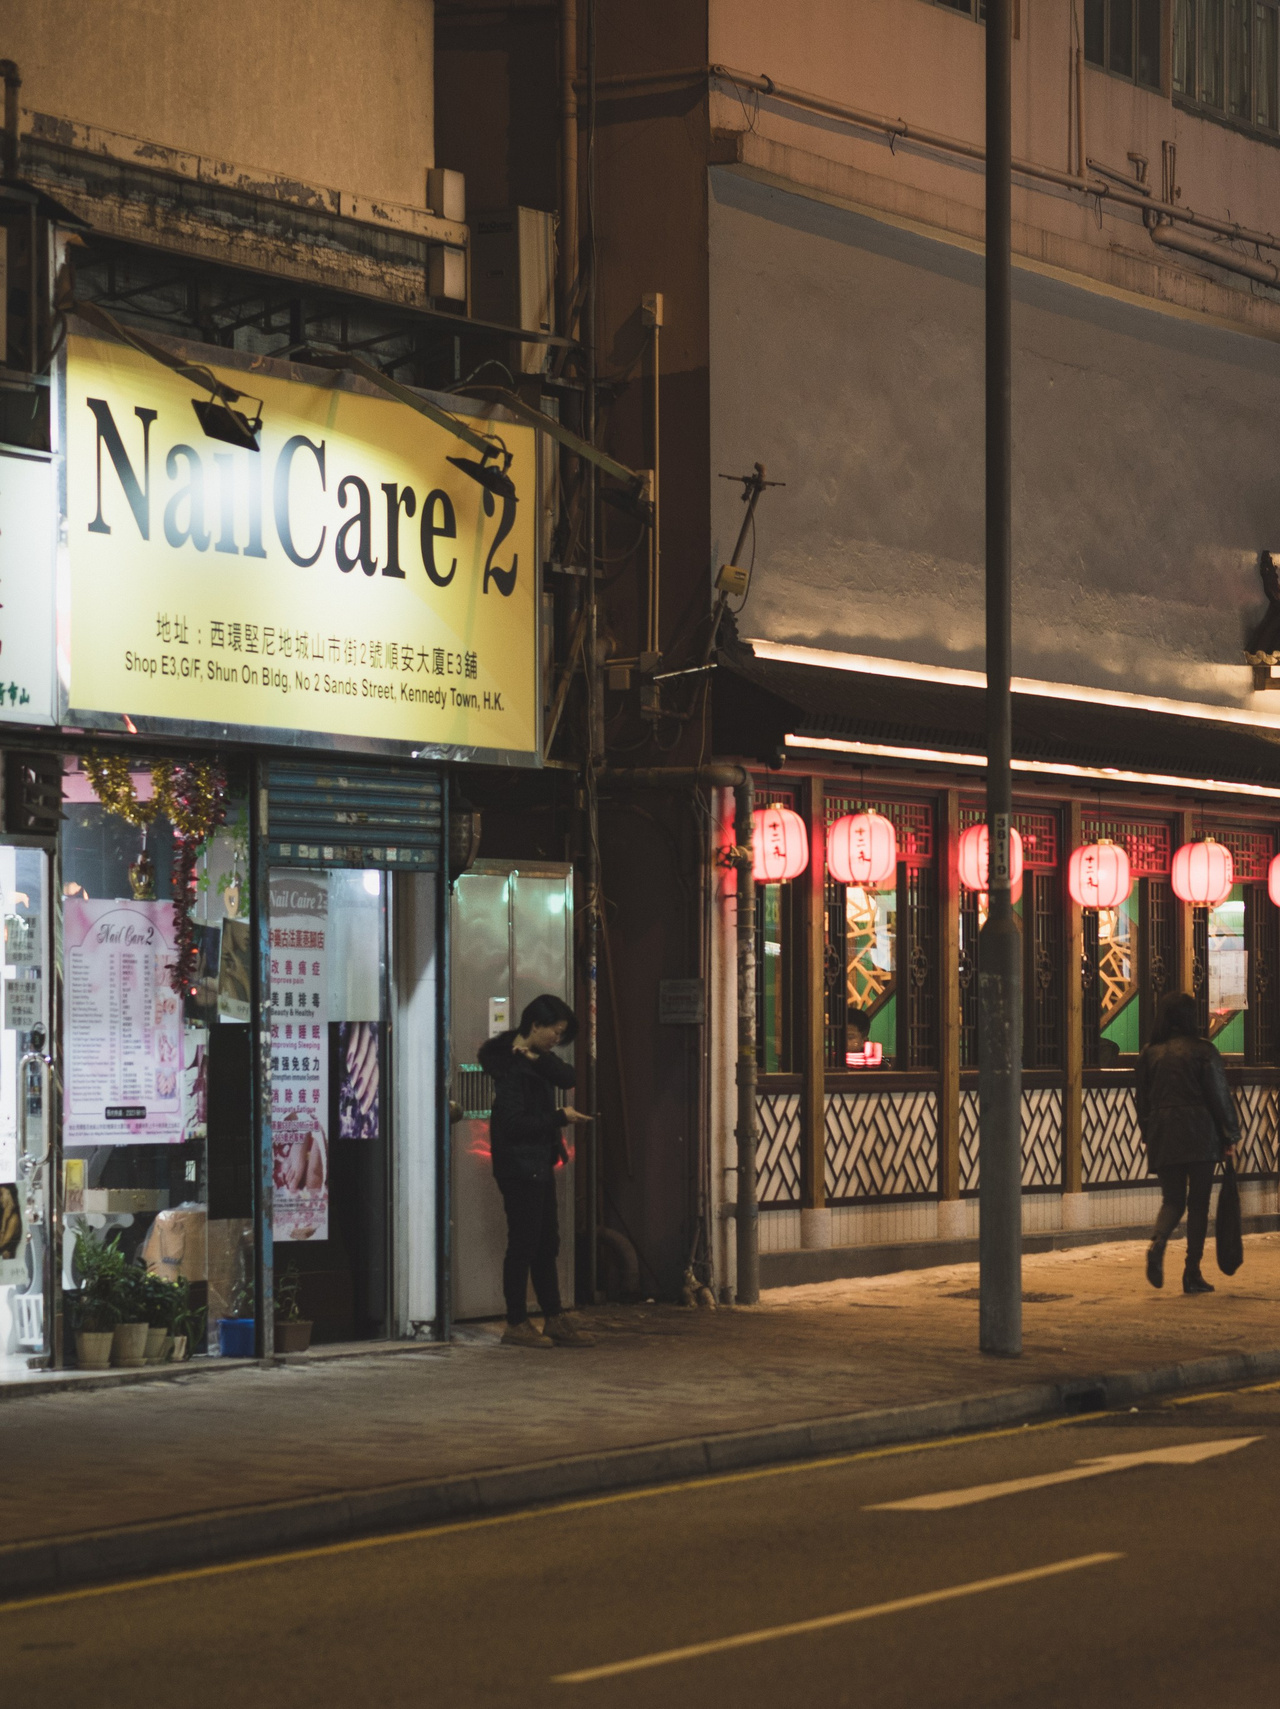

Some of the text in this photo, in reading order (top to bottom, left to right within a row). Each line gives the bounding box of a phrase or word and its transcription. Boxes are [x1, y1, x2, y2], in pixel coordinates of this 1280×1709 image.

[483, 483, 519, 597] 2
[125, 650, 157, 678] Shop
[207, 660, 238, 682] Shun
[241, 664, 258, 685] On
[262, 667, 292, 693] Bldg,
[295, 670, 311, 691] No
[314, 673, 320, 691] 2
[323, 674, 358, 696] Sands
[361, 678, 397, 703] Street,
[400, 682, 447, 710] Kennedy
[450, 687, 481, 712] Town,
[483, 691, 505, 711] H.K.
[270, 890, 289, 908] Nail
[317, 892, 323, 909] 2
[97, 923, 154, 947] Nail Care 2
[271, 960, 320, 976] 改善痛症
[271, 1008, 289, 1017] Beauty
[294, 1008, 314, 1017] Healthy
[271, 1024, 320, 1039] 改善睡眠
[271, 1041, 320, 1050] Improving Sleeping
